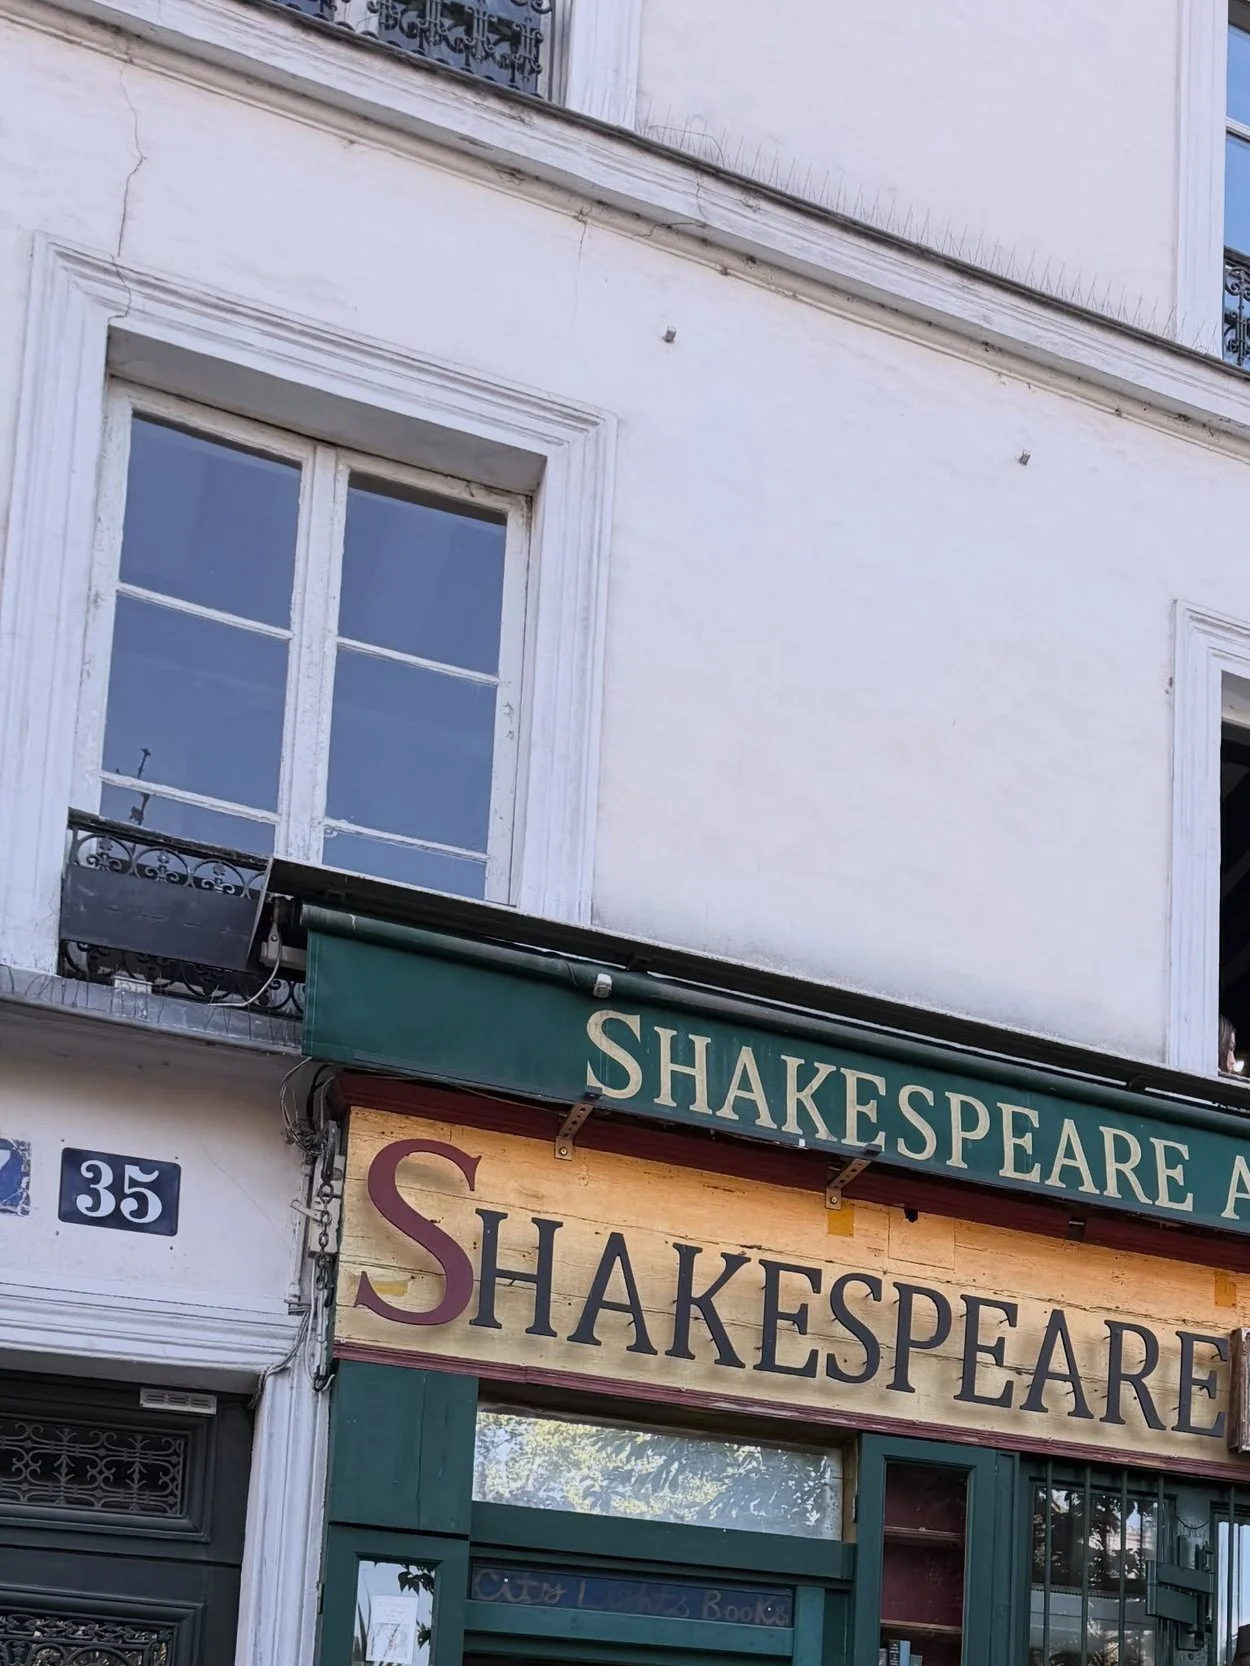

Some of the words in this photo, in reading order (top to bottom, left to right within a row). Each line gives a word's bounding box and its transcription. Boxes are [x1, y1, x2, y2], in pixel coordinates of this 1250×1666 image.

[586, 1010, 1193, 1212] SHAKESPEARE
[76, 1160, 162, 1223] 35
[354, 1138, 1228, 1438] SHAKESPEARE
[474, 1568, 567, 1604] City
